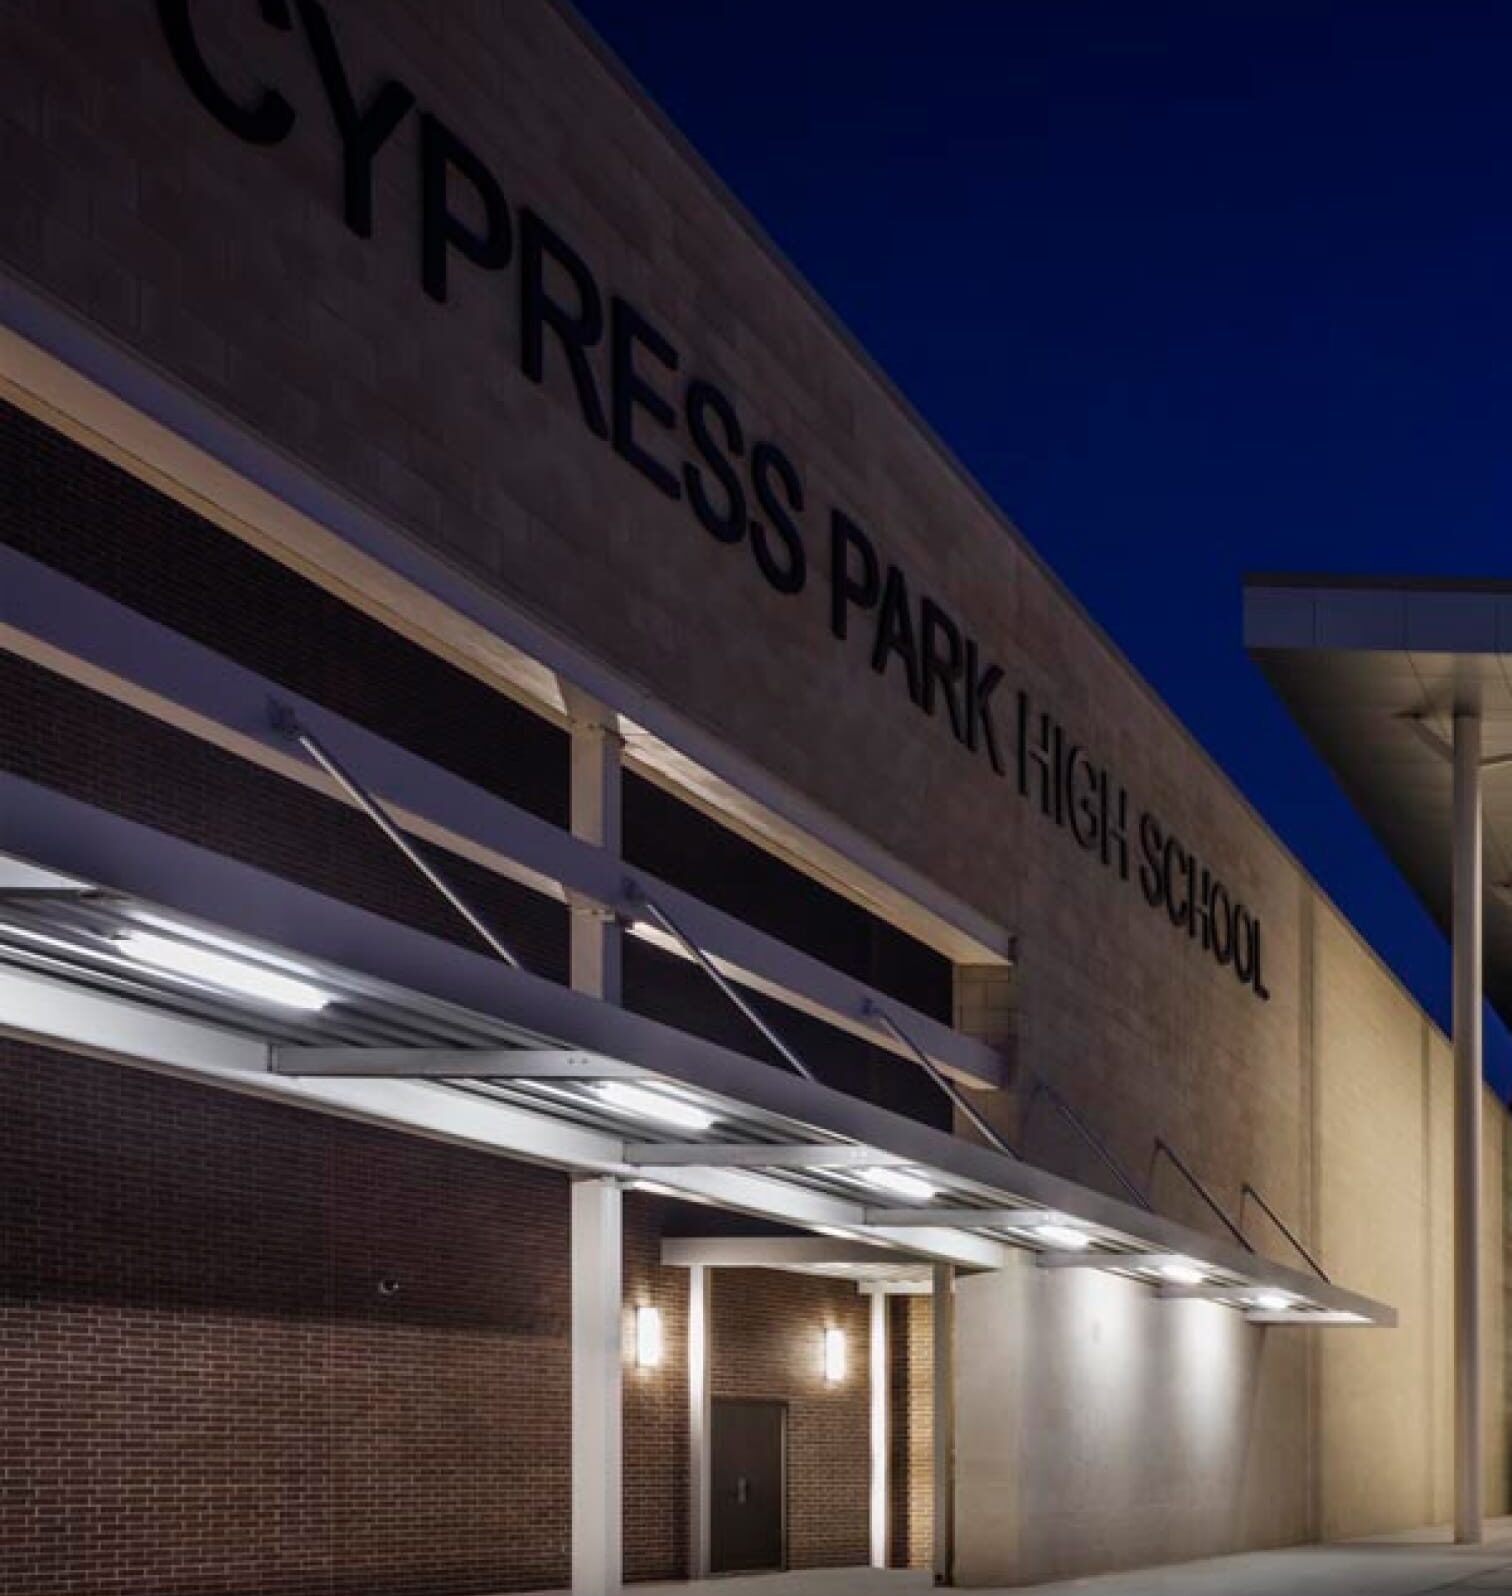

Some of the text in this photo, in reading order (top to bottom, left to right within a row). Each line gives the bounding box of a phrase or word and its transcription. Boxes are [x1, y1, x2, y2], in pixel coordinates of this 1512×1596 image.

[156, 0, 1269, 1000] CYPRESS PARK HIGH SCHOOL
